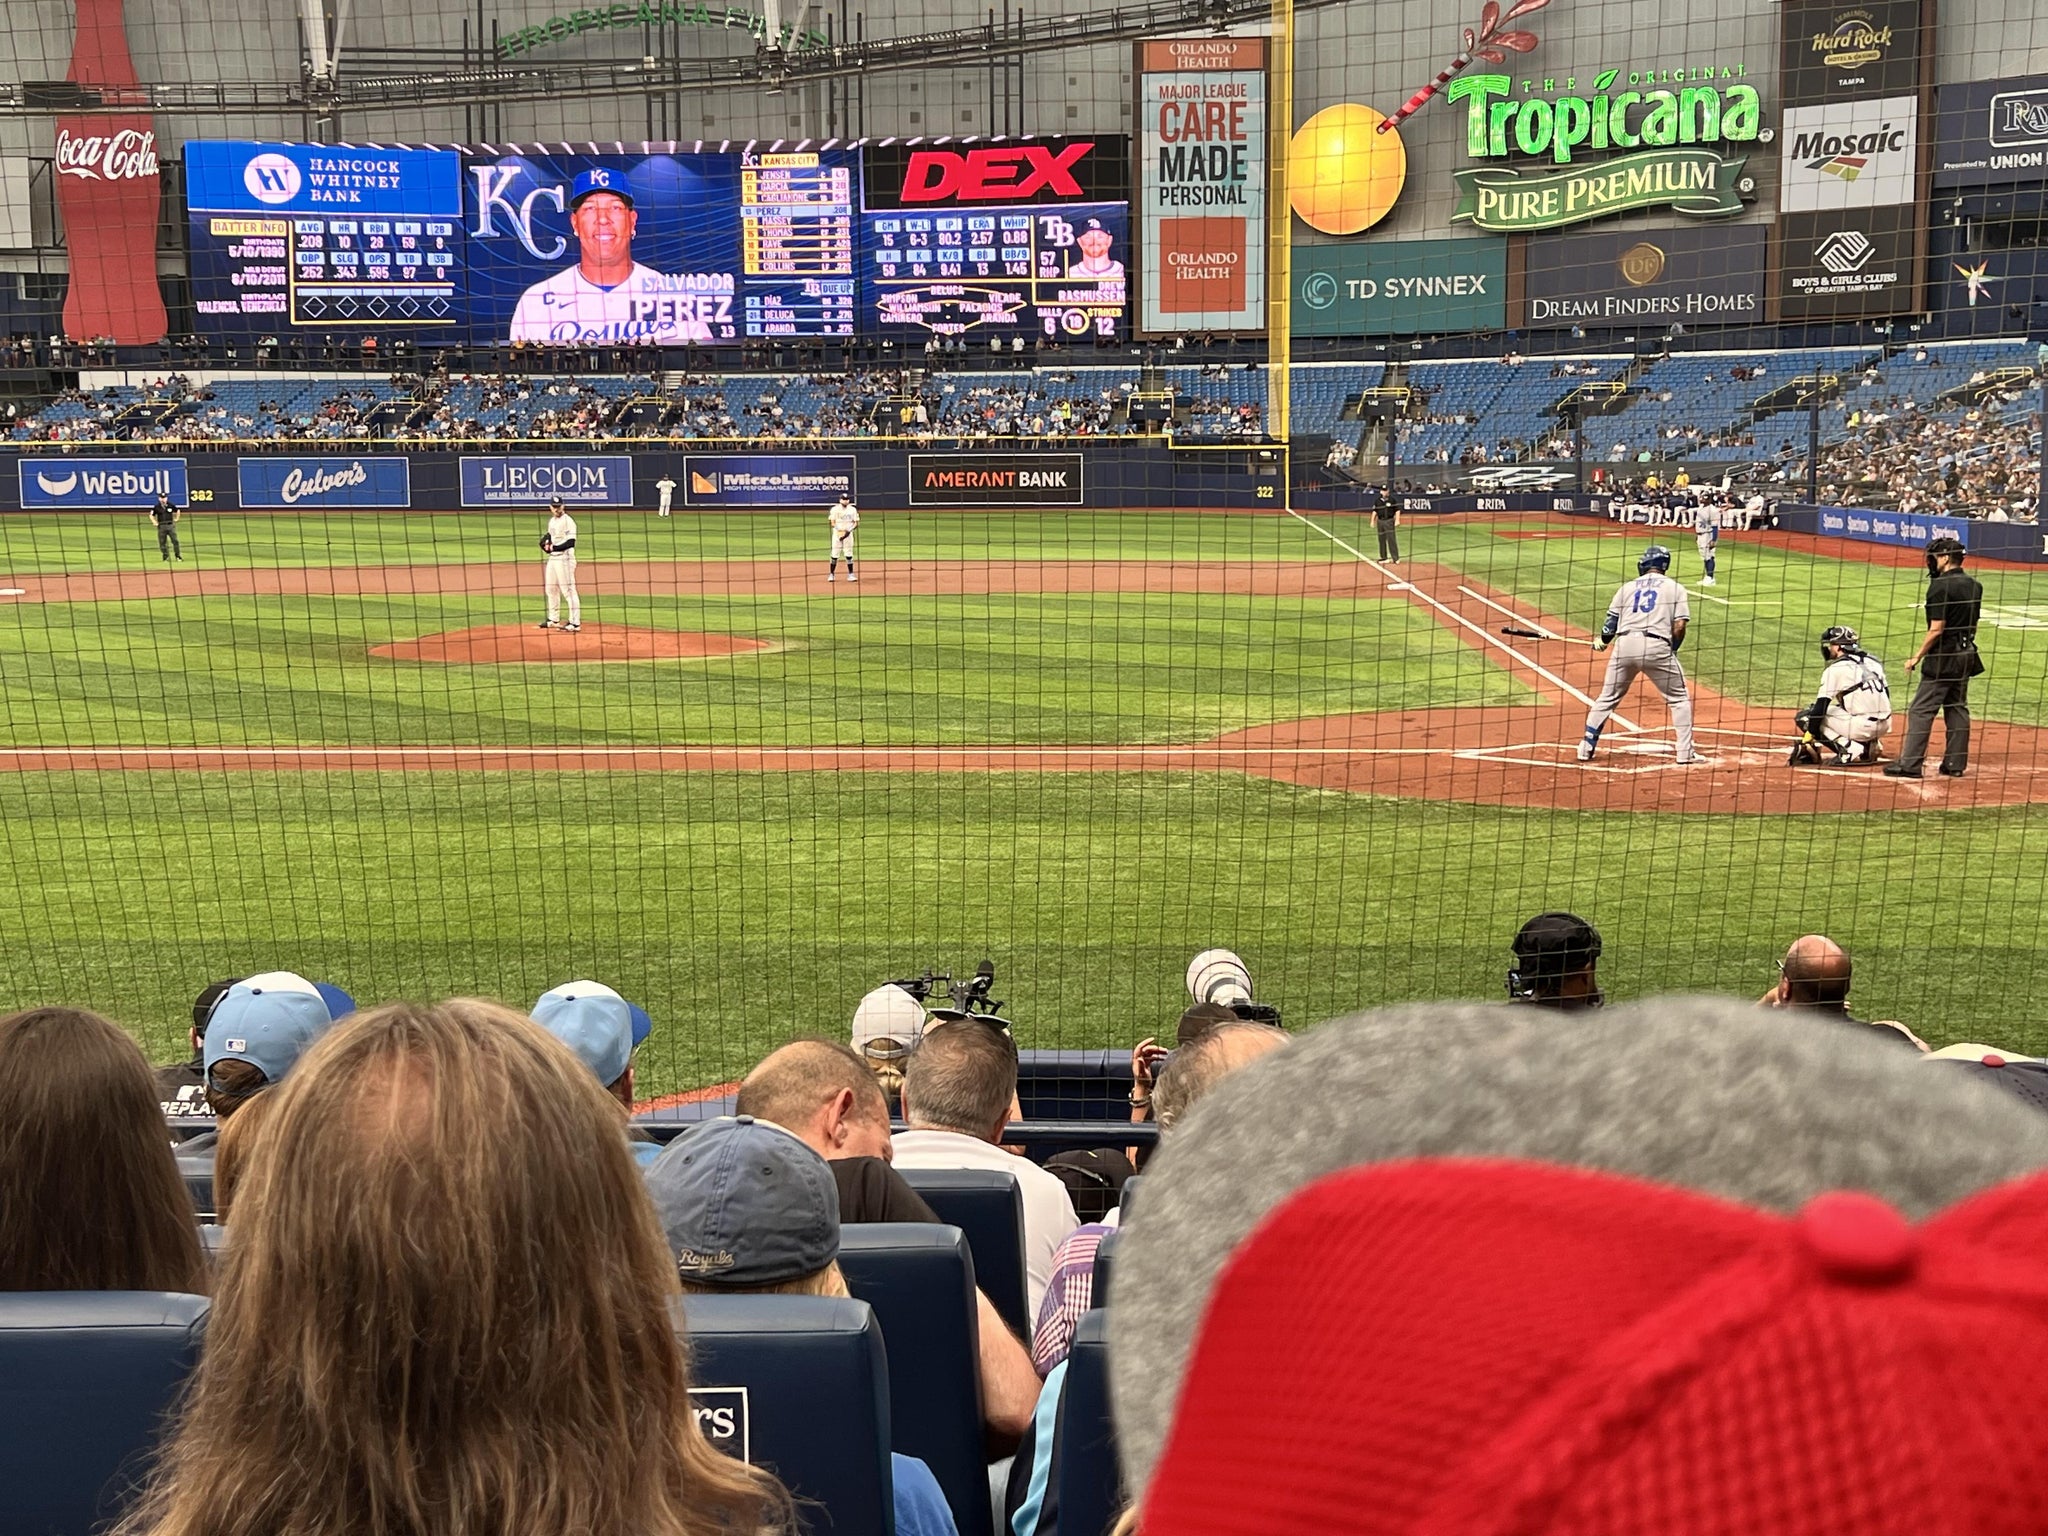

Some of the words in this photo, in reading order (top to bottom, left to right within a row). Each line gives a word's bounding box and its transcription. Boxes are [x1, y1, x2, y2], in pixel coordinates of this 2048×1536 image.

[497, 3, 711, 59] TROPICANA
[1812, 30, 1853, 51] Hard
[1853, 25, 1892, 49] Rock
[1169, 43, 1237, 56] ORLANDO
[1177, 56, 1230, 69] HEALTH
[1522, 77, 1576, 93] THE
[1629, 63, 1748, 86] ORIGINAL
[1838, 77, 1865, 86] TAMPA
[1159, 85, 1200, 99] MAJOR
[1203, 83, 1247, 98] LEAGUE
[1159, 101, 1247, 143] CARE
[1448, 70, 1760, 163] Tropicana
[1791, 122, 1905, 160] Mosaic
[56, 129, 159, 181] Coca-Cola
[764, 157, 796, 165] KANSAS
[798, 156, 816, 165] CITY
[1944, 161, 1978, 169] Presented
[1978, 160, 1987, 168] by
[1990, 152, 2043, 170] UNION
[310, 158, 400, 174] HANCOCK
[1159, 144, 1247, 183] MADE
[590, 169, 610, 187] KC
[760, 171, 791, 180] JENSEN
[901, 143, 1096, 202] DEX
[310, 174, 401, 189] WHITNEY
[760, 182, 789, 191] GARCIA
[311, 189, 362, 203] BANK
[1159, 185, 1247, 207] PERSONAL
[1477, 187, 1560, 221] PURE
[1567, 161, 1717, 211] PREMIUM
[469, 165, 567, 260] KC
[756, 207, 781, 216] PEREZ
[214, 222, 257, 232] BATTER
[261, 223, 284, 233] INFO
[301, 221, 319, 232] AVG
[338, 223, 350, 233] HR
[369, 224, 384, 233] RBI
[434, 225, 445, 233] 2B
[761, 217, 792, 226] MASSEY
[882, 222, 894, 230] GM
[910, 221, 927, 230] W-L
[945, 220, 954, 229] IP
[973, 219, 991, 229] ERA
[1003, 218, 1027, 228] WHIP
[762, 229, 794, 237] THOMAS
[1038, 215, 1075, 247] TB
[298, 235, 323, 248] .208
[338, 236, 351, 249] 10
[369, 236, 384, 249] 28
[763, 240, 783, 249] RAVE
[882, 234, 894, 246] 15
[909, 233, 928, 246] 6-3
[938, 232, 962, 245] 80.2
[301, 254, 320, 263] OBP
[337, 254, 353, 263] SLG
[369, 254, 386, 263] OPS
[404, 254, 415, 263] TB
[434, 254, 446, 263] 3B
[762, 251, 791, 259] LOFTIN
[942, 250, 959, 260] K/9
[976, 250, 989, 260] BB
[1004, 249, 1028, 259] BB/9
[1040, 251, 1056, 266] 57
[1168, 252, 1238, 266] ORLANDO
[334, 266, 357, 279] .343
[367, 266, 389, 279] .595
[402, 266, 416, 279] 97
[763, 262, 796, 271] COLLINS
[882, 263, 896, 277] 58
[912, 263, 926, 276] 84
[940, 262, 962, 276] 9.41
[976, 262, 989, 276] 13
[1004, 262, 1028, 276] 1.45
[1039, 266, 1060, 278] RHP
[1176, 266, 1230, 280] HEALTH
[644, 273, 734, 292] SALVADOR
[1098, 282, 1126, 291] DREW
[1346, 277, 1377, 300] TD
[1384, 274, 1487, 298] SYNNEX
[1792, 277, 1820, 287] BOYS
[1821, 276, 1830, 286] &
[1831, 275, 1861, 285] GIRLS
[1863, 273, 1897, 283] CLUBS
[823, 284, 839, 293] DUE
[840, 284, 851, 294] UP
[930, 285, 965, 295] DELUCA
[1847, 284, 1869, 292] TAMPA
[543, 292, 555, 305] C
[880, 294, 918, 304] SIMPSON
[1058, 290, 1126, 302] RASMUSSEN
[635, 295, 733, 323] PEREZ
[1037, 308, 1063, 317] BALLS
[1087, 308, 1123, 317] STRIKES
[1533, 298, 1599, 320] DREAM
[1604, 295, 1680, 316] FINDERS
[1686, 293, 1756, 314] HOMES
[764, 310, 795, 319] DELUCA
[880, 313, 923, 323] CAMINERO
[980, 313, 1018, 323] ARANDA
[720, 325, 736, 338] 13
[764, 323, 796, 333] ARANDA
[932, 323, 966, 333] FORTES
[1044, 317, 1056, 335] 6
[1068, 315, 1083, 329] 18
[1095, 317, 1115, 336] 12
[81, 470, 170, 495] Webull
[281, 461, 367, 504] Culver's
[925, 471, 1016, 488] AMERANT
[1019, 471, 1067, 487] BANK
[190, 490, 214, 502] 382
[1256, 486, 1273, 499] 322
[1632, 589, 1658, 613] 13
[679, 1247, 735, 1272] Royals
